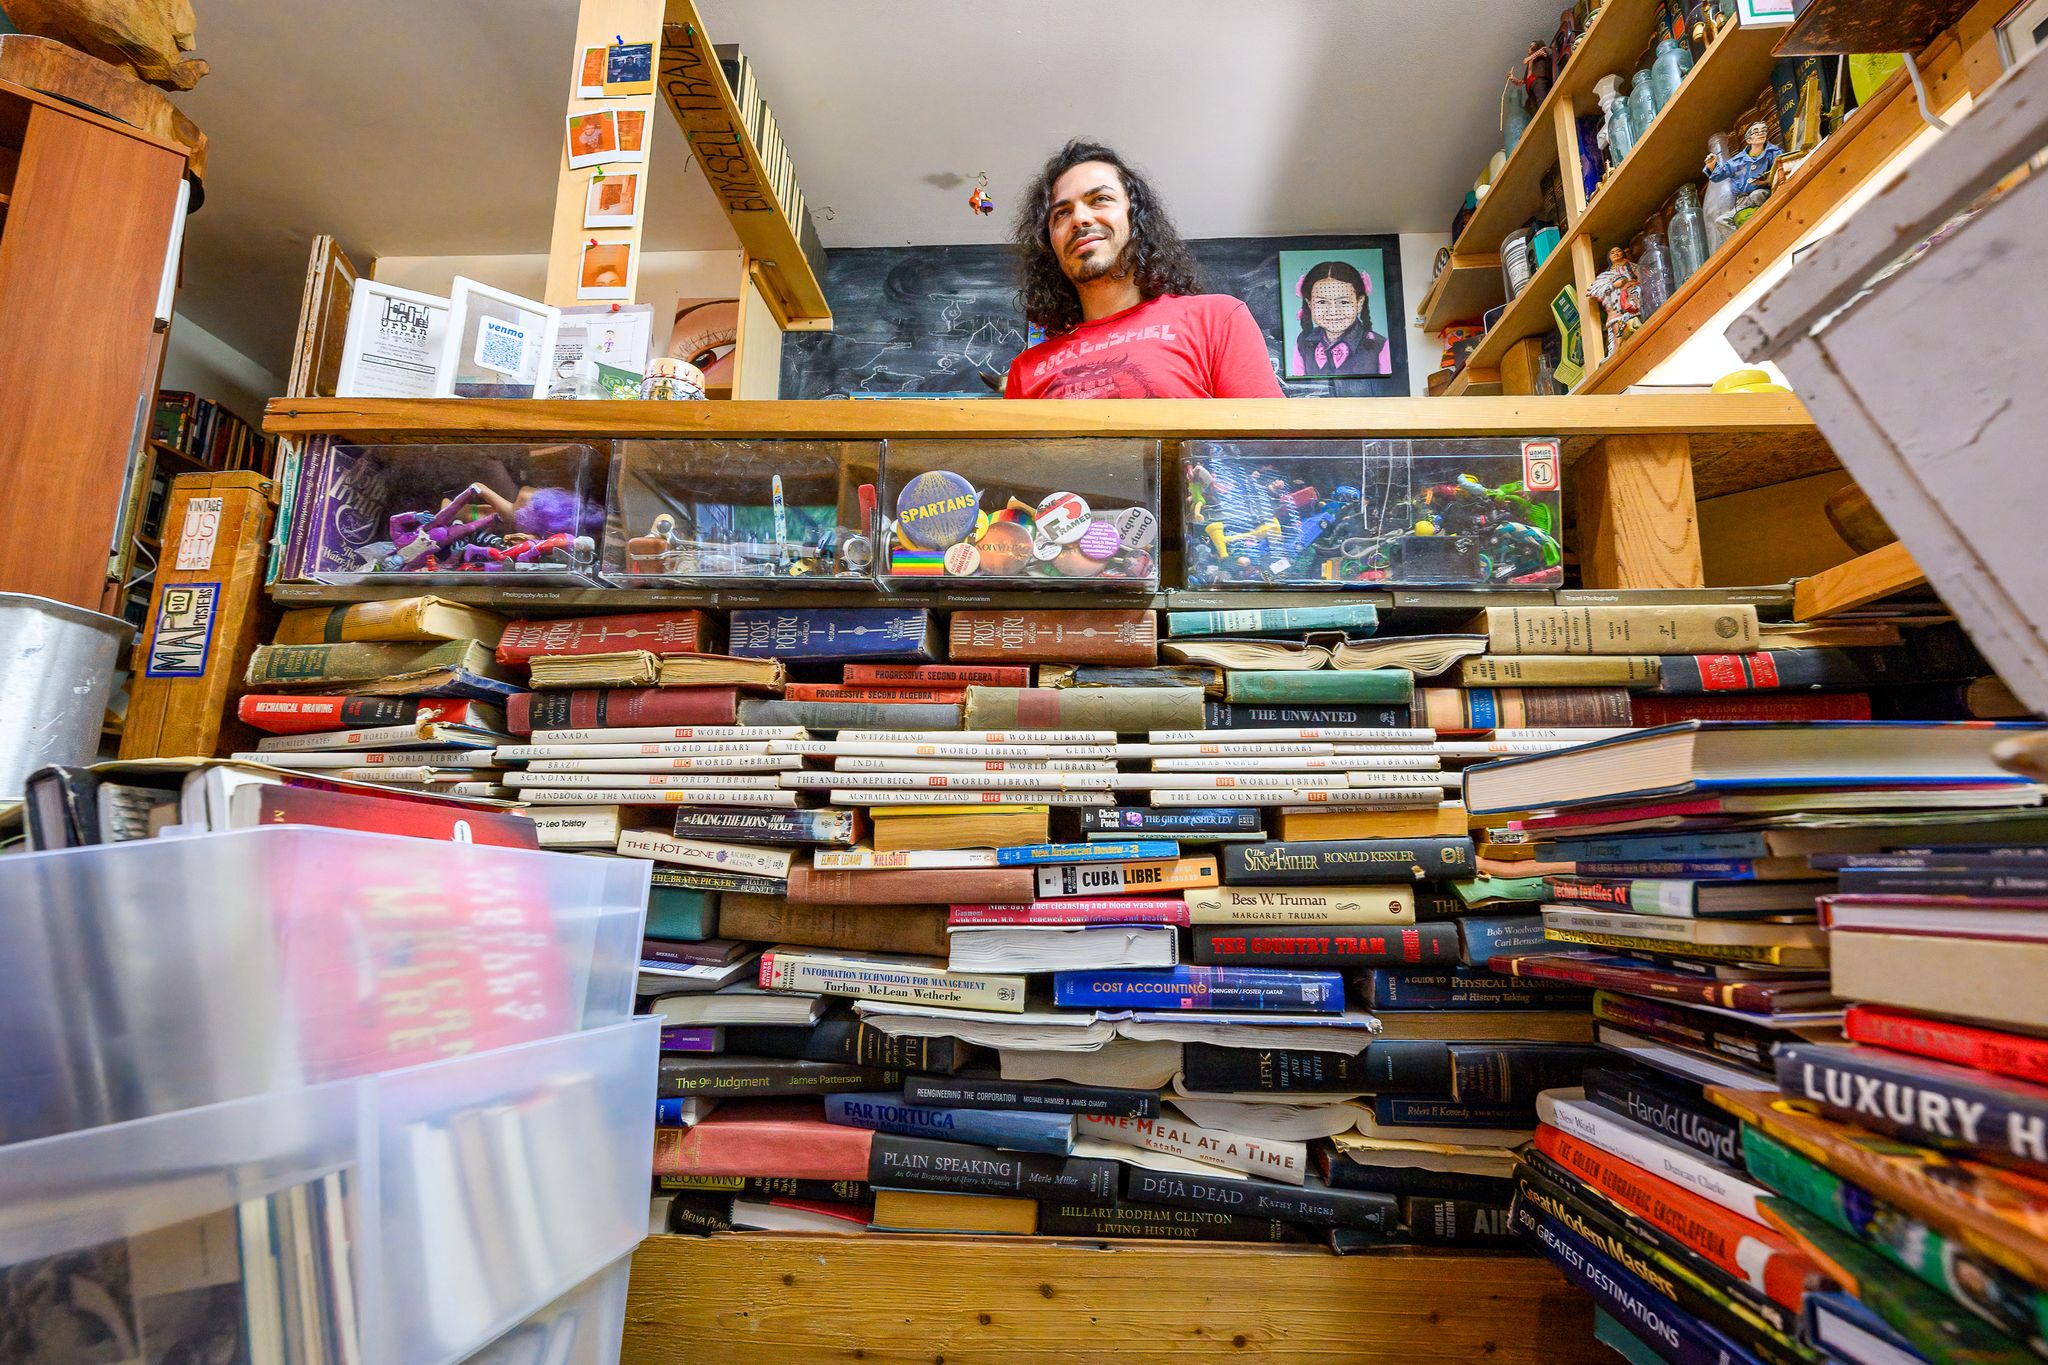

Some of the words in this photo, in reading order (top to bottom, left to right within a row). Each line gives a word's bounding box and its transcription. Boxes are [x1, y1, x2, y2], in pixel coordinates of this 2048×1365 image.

[690, 122, 748, 173] SELL
[714, 177, 772, 213] BUY
[381, 319, 428, 336] Urban
[488, 322, 524, 339] venmo
[1535, 464, 1548, 482] $1
[189, 499, 222, 512] VINTAGE
[901, 494, 976, 524] SPARTANS
[185, 514, 216, 538] US
[1043, 511, 1092, 541] FRAMED
[1119, 508, 1141, 541] Dubya
[1131, 515, 1152, 546] Dump
[180, 539, 213, 555] CITY
[177, 556, 210, 570] MAPS
[174, 595, 185, 613] $10
[193, 587, 213, 633] POSTERS
[750, 620, 770, 648] PROSE
[775, 616, 798, 650] POETRY
[973, 619, 995, 647] PROSE
[1002, 616, 1024, 649] POETRY
[152, 613, 201, 672] MAP
[875, 670, 924, 680] PROGRESSIVE
[927, 670, 957, 681] SECOND
[958, 671, 993, 682] ALGEBRA
[816, 689, 865, 699] PROGRESSIVE
[867, 689, 897, 700] SECOND
[900, 690, 932, 700] ALGEBRA
[255, 702, 298, 713] MECHANICAL
[301, 702, 334, 714] DRAWING
[558, 697, 567, 723] World
[1249, 708, 1277, 721] THE
[1281, 708, 1357, 723] UNWANTED
[548, 732, 588, 740] CANADA
[676, 729, 692, 737] LIFE
[697, 729, 734, 737] WORLD
[740, 728, 783, 736] LIBRARY
[1512, 730, 1557, 738] BRITAIN
[512, 748, 551, 756] GREECE
[786, 743, 827, 752] MEXICO
[853, 760, 884, 768] INDIA
[986, 762, 1003, 770] LIFE
[1009, 762, 1047, 770] WORLD
[1054, 762, 1097, 771] LIBRARY
[520, 774, 591, 783] SCANDINAVIA
[797, 776, 815, 784] THE
[819, 777, 858, 785] ANDEAN
[862, 777, 914, 785] REPUBLICS
[930, 777, 945, 785] LIFE
[952, 777, 991, 786] WORLD
[997, 778, 1041, 786] LIBRARY
[1392, 774, 1440, 782] BALKANS
[535, 792, 584, 801] HANDBOOK
[587, 792, 598, 800] OF
[620, 792, 657, 800] NATIONS
[849, 792, 889, 801] AUSTRALIA
[892, 793, 910, 801] AND
[932, 793, 970, 801] ZEALAND
[1005, 793, 1044, 802] WORLD
[1051, 793, 1095, 803] LIBRARY
[1171, 793, 1190, 801] THE
[1197, 793, 1217, 801] LOW
[1222, 793, 1283, 801] COUNTRIES
[1332, 792, 1371, 801] WORLD
[1379, 791, 1424, 800] LIBRARY
[546, 819, 560, 828] Leo
[561, 819, 587, 829] Tolstoy
[690, 813, 723, 826] FACING
[740, 816, 768, 828] LIONS
[768, 822, 793, 831] WICKER
[1100, 818, 1120, 828] Potok
[1144, 815, 1160, 824] THE
[1160, 815, 1180, 826] GIFT
[1189, 815, 1216, 826] ASHER
[1217, 815, 1233, 825] LEV
[626, 840, 650, 851] THE
[653, 841, 681, 855] HOT
[683, 848, 714, 860] ZONE
[1031, 848, 1049, 858] New
[1050, 846, 1087, 857] American
[1091, 845, 1123, 855] Review
[1324, 851, 1367, 864] RONALD
[1370, 851, 1416, 863] KESSLER
[873, 854, 908, 866] KILLSHOT
[1244, 848, 1271, 871] SINS
[1274, 848, 1320, 871] FATHER
[701, 876, 737, 887] PICKERS
[1082, 870, 1119, 887] CUBA
[1123, 867, 1162, 885] LIBRE
[1232, 892, 1258, 906] Bess
[1258, 893, 1274, 906] W.
[1276, 892, 1327, 906] Truman
[1554, 882, 1578, 900] techno
[1580, 884, 1613, 901] textiles
[1614, 886, 1627, 904] 2
[1435, 901, 1461, 913] THE
[1231, 912, 1283, 920] MARGARET
[1288, 912, 1328, 920] TRUMAN
[1487, 927, 1503, 937] Bob
[1211, 938, 1245, 954] THE
[1251, 938, 1329, 954] COUNTRY
[1335, 938, 1386, 955] TEAM
[1494, 939, 1512, 948] Carl
[802, 967, 857, 980] INFORMATION
[859, 971, 911, 984] TECHNOLOGY
[913, 974, 929, 985] FOR
[931, 977, 986, 990] MANAGEMENT
[1411, 976, 1434, 984] GUIDE
[1436, 976, 1446, 984] TO
[1451, 975, 1507, 989] PHYSICAL
[824, 981, 860, 994] Turban
[867, 983, 908, 997] McLean
[912, 988, 961, 1002] Wetherbe
[1093, 981, 1122, 994] COST
[1126, 982, 1207, 995] ACCOUNTING
[676, 1077, 697, 1090] The
[699, 1077, 712, 1089] 9th
[713, 1075, 770, 1090] Judgment
[788, 1075, 818, 1085] James
[819, 1073, 862, 1085] Patterson
[917, 1088, 961, 1100] REENGINEERING
[964, 1091, 975, 1100] THE
[977, 1091, 1017, 1102] CORPORATION
[845, 1101, 873, 1118] FAR
[875, 1103, 955, 1130] TORTUGA
[1804, 1062, 1987, 1145] LUXURY
[2007, 1111, 2048, 1163] H
[1575, 1115, 1596, 1135] World
[1628, 1092, 1679, 1136] Harold
[1681, 1113, 1736, 1160] Lloyd
[1086, 1113, 1134, 1130] ONE
[1136, 1120, 1191, 1144] MEAL
[1199, 1136, 1221, 1150] AT
[1226, 1143, 1239, 1156] A
[1246, 1143, 1295, 1169] TIME
[884, 1152, 930, 1169] PLAIN
[935, 1156, 1011, 1176] SPEAKING
[1028, 1172, 1052, 1184] Merle
[1054, 1173, 1079, 1185] Miller
[1664, 1158, 1696, 1183] Duncan
[1698, 1173, 1727, 1196] Clarke
[1143, 1177, 1185, 1197] DÉJÀ
[1192, 1183, 1243, 1204] DEAD
[1558, 1140, 1570, 1163] THE
[1572, 1148, 1600, 1179] GOLDEN
[1603, 1164, 1651, 1207] GEOGRAPHIC
[1653, 1194, 1727, 1257] ENCYCLOPEDIA
[1061, 1206, 1113, 1220] HILLARY
[1117, 1208, 1170, 1222] RODHAM
[1175, 1211, 1233, 1225] CLINTON
[1096, 1222, 1140, 1235] LIVING
[1145, 1224, 1199, 1238] HISTORY
[1519, 1179, 1552, 1207] Great
[1551, 1196, 1606, 1251] Modern
[1607, 1235, 1679, 1301] Masters
[1519, 1210, 1535, 1231] 200
[1536, 1224, 1584, 1271] GREATEST
[1586, 1262, 1681, 1349] DESTINATIONS
